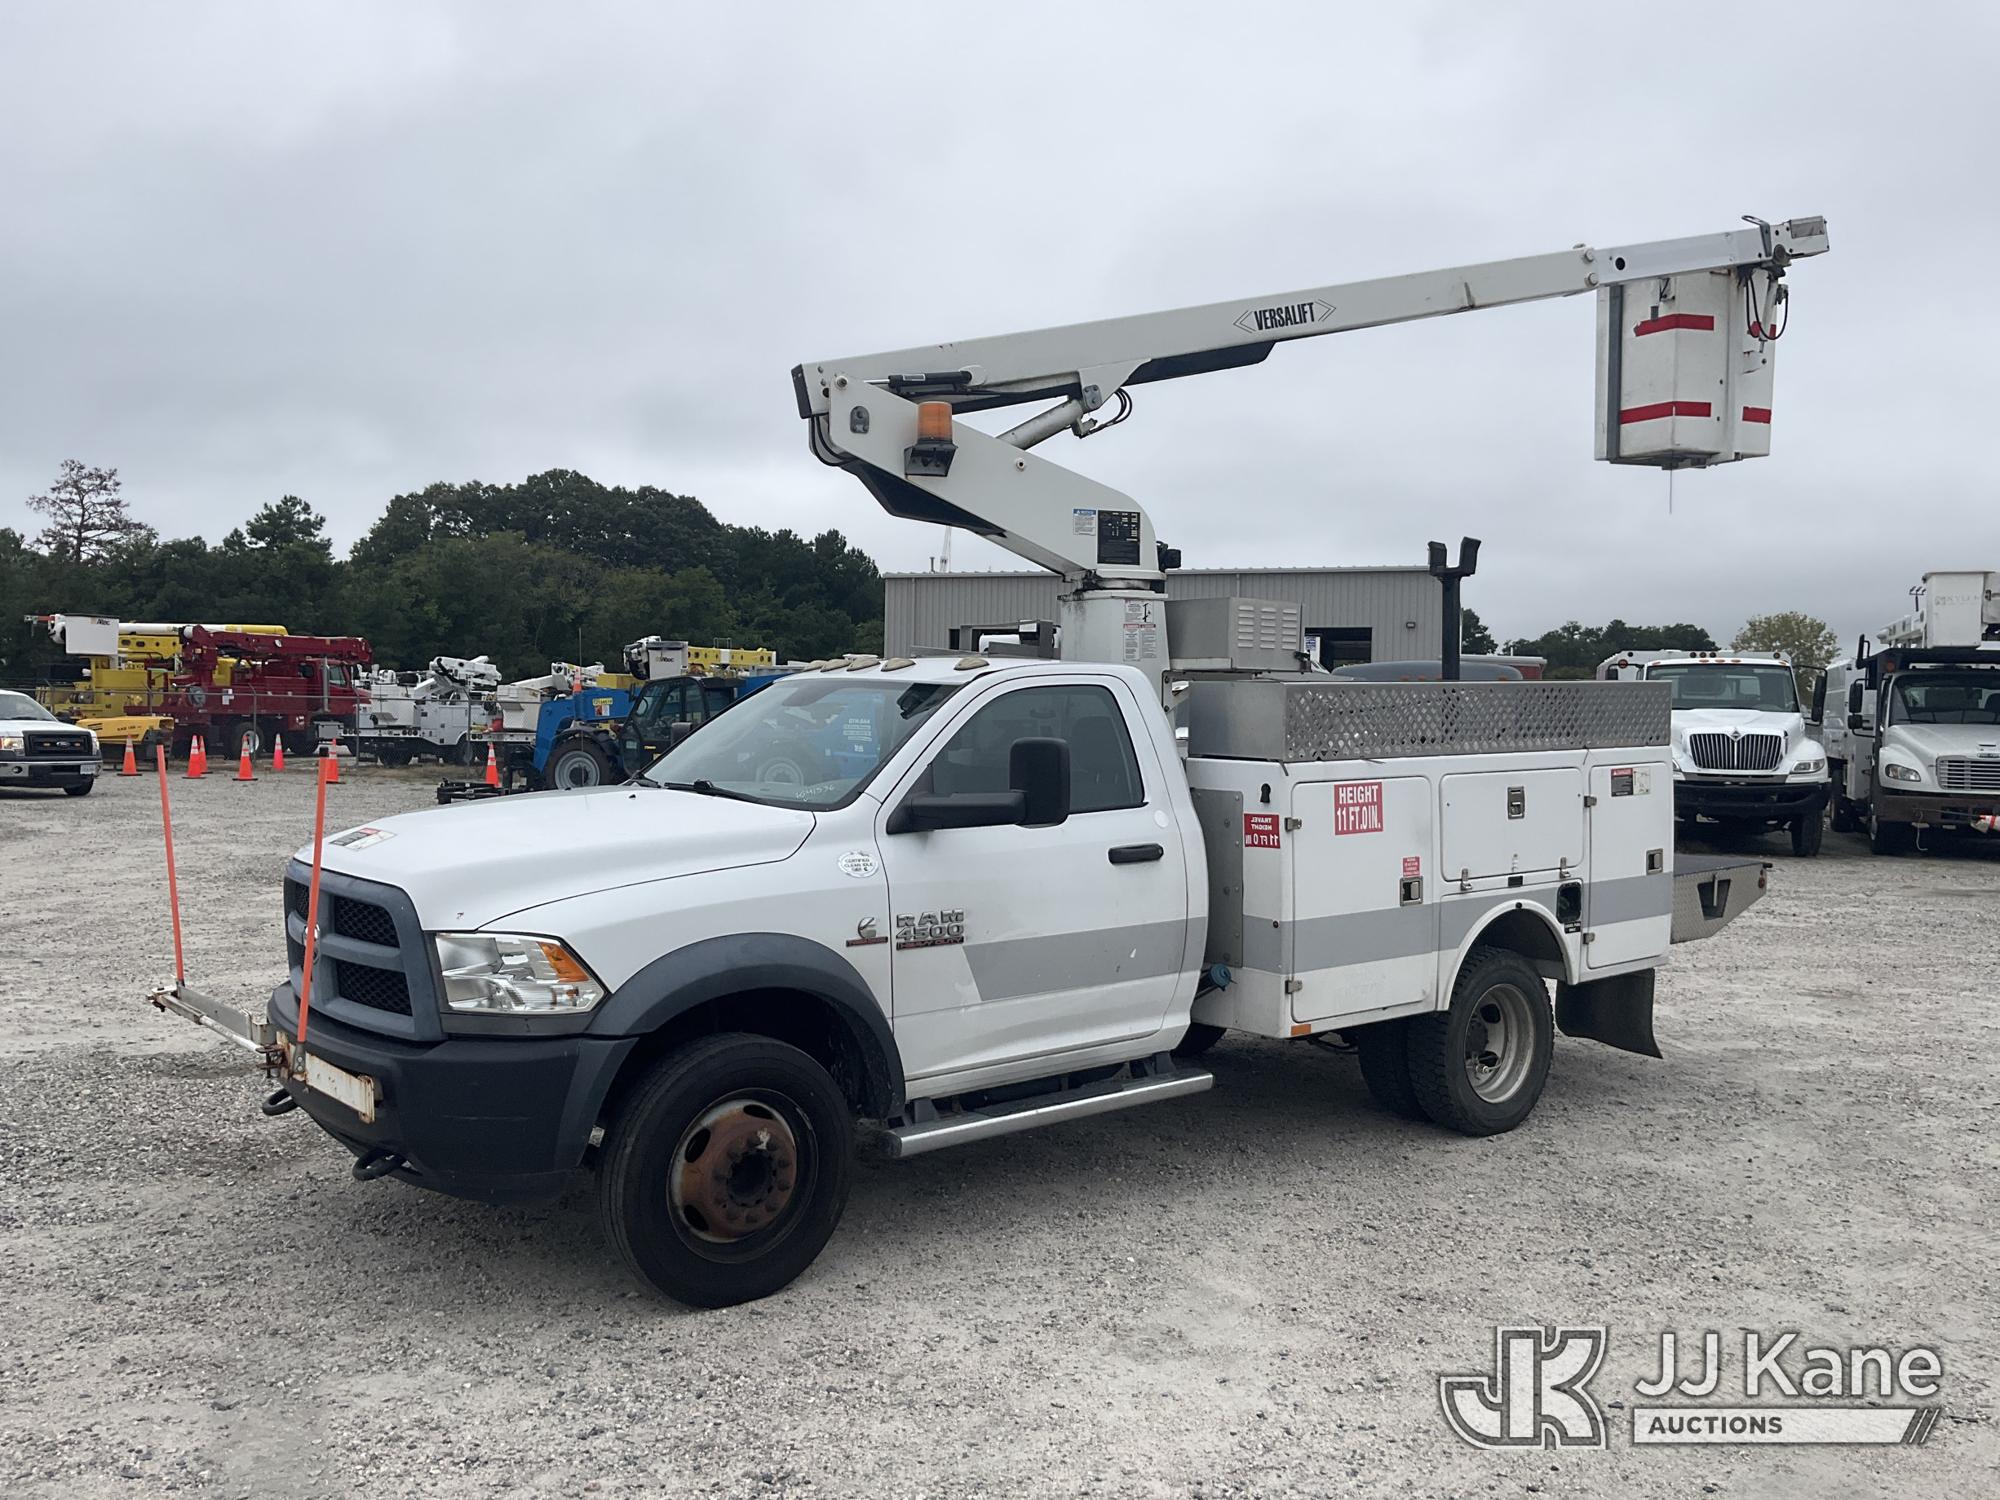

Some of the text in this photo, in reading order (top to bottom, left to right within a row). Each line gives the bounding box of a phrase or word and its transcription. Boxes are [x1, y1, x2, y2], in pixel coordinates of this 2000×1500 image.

[1254, 302, 1315, 331] VERSALIFT
[1339, 785, 1379, 804] HEIGHT
[896, 909, 964, 928] RAM
[896, 922, 964, 941] 4500
